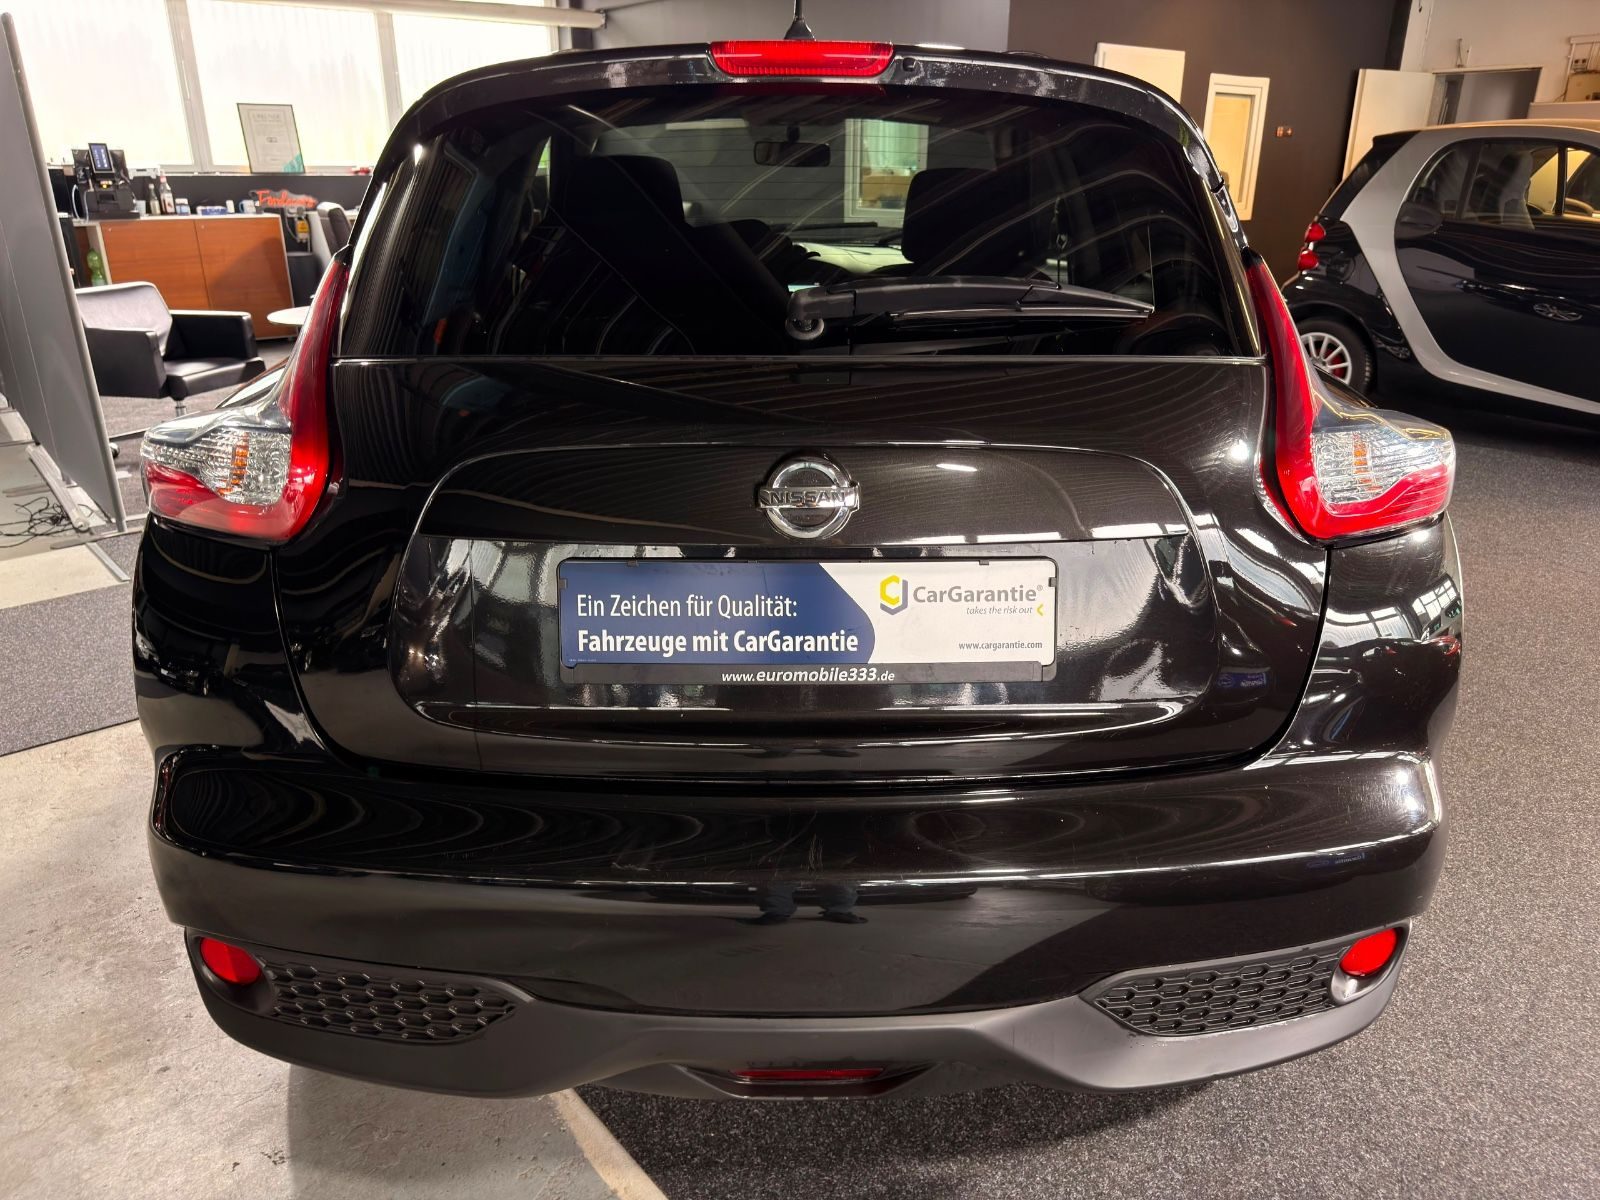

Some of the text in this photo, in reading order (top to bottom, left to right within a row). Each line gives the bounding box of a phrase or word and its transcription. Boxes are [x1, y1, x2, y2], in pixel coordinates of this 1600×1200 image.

[769, 490, 845, 504] NISSAN
[577, 594, 798, 619] Ein Zeichen für Qualität:
[966, 606, 1033, 615] takes the risk out
[578, 629, 859, 657] Fahrzeuge mit CarGarantie
[958, 640, 1043, 652] www.cargarantie.com
[721, 667, 896, 683] www.euromobile333.de
